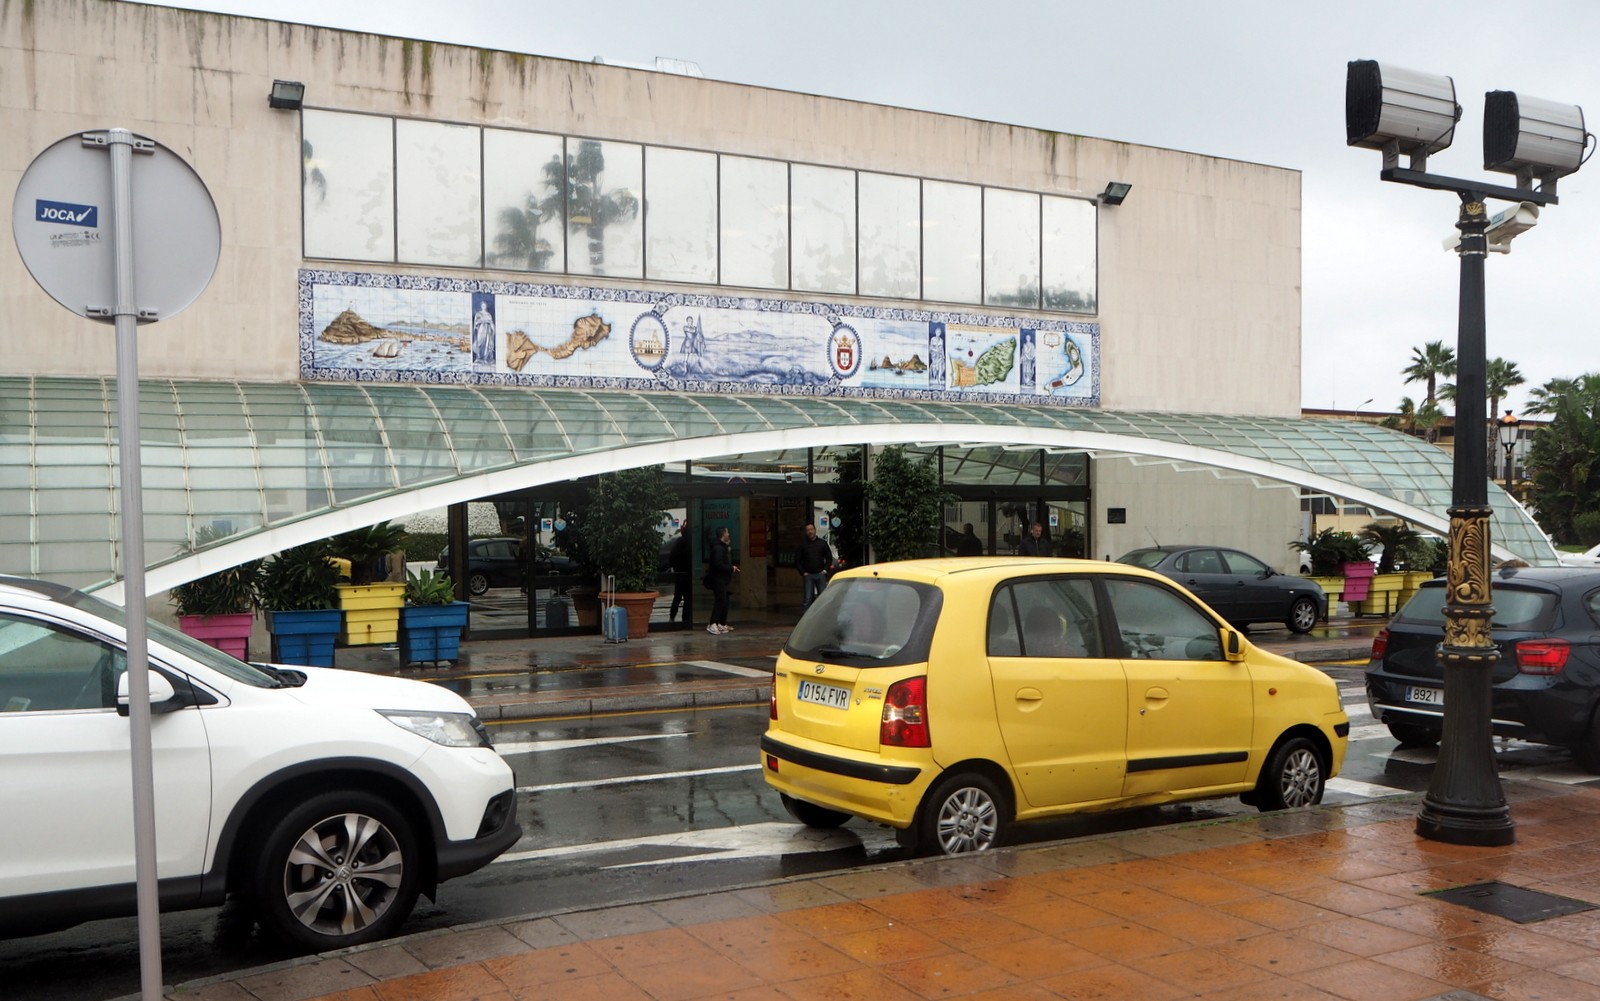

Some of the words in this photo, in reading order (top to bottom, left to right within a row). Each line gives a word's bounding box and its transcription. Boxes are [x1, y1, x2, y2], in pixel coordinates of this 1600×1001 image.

[41, 207, 76, 222] JOCA
[803, 683, 827, 703] 0154
[827, 688, 848, 707] FVR
[1413, 688, 1438, 703] 8921
